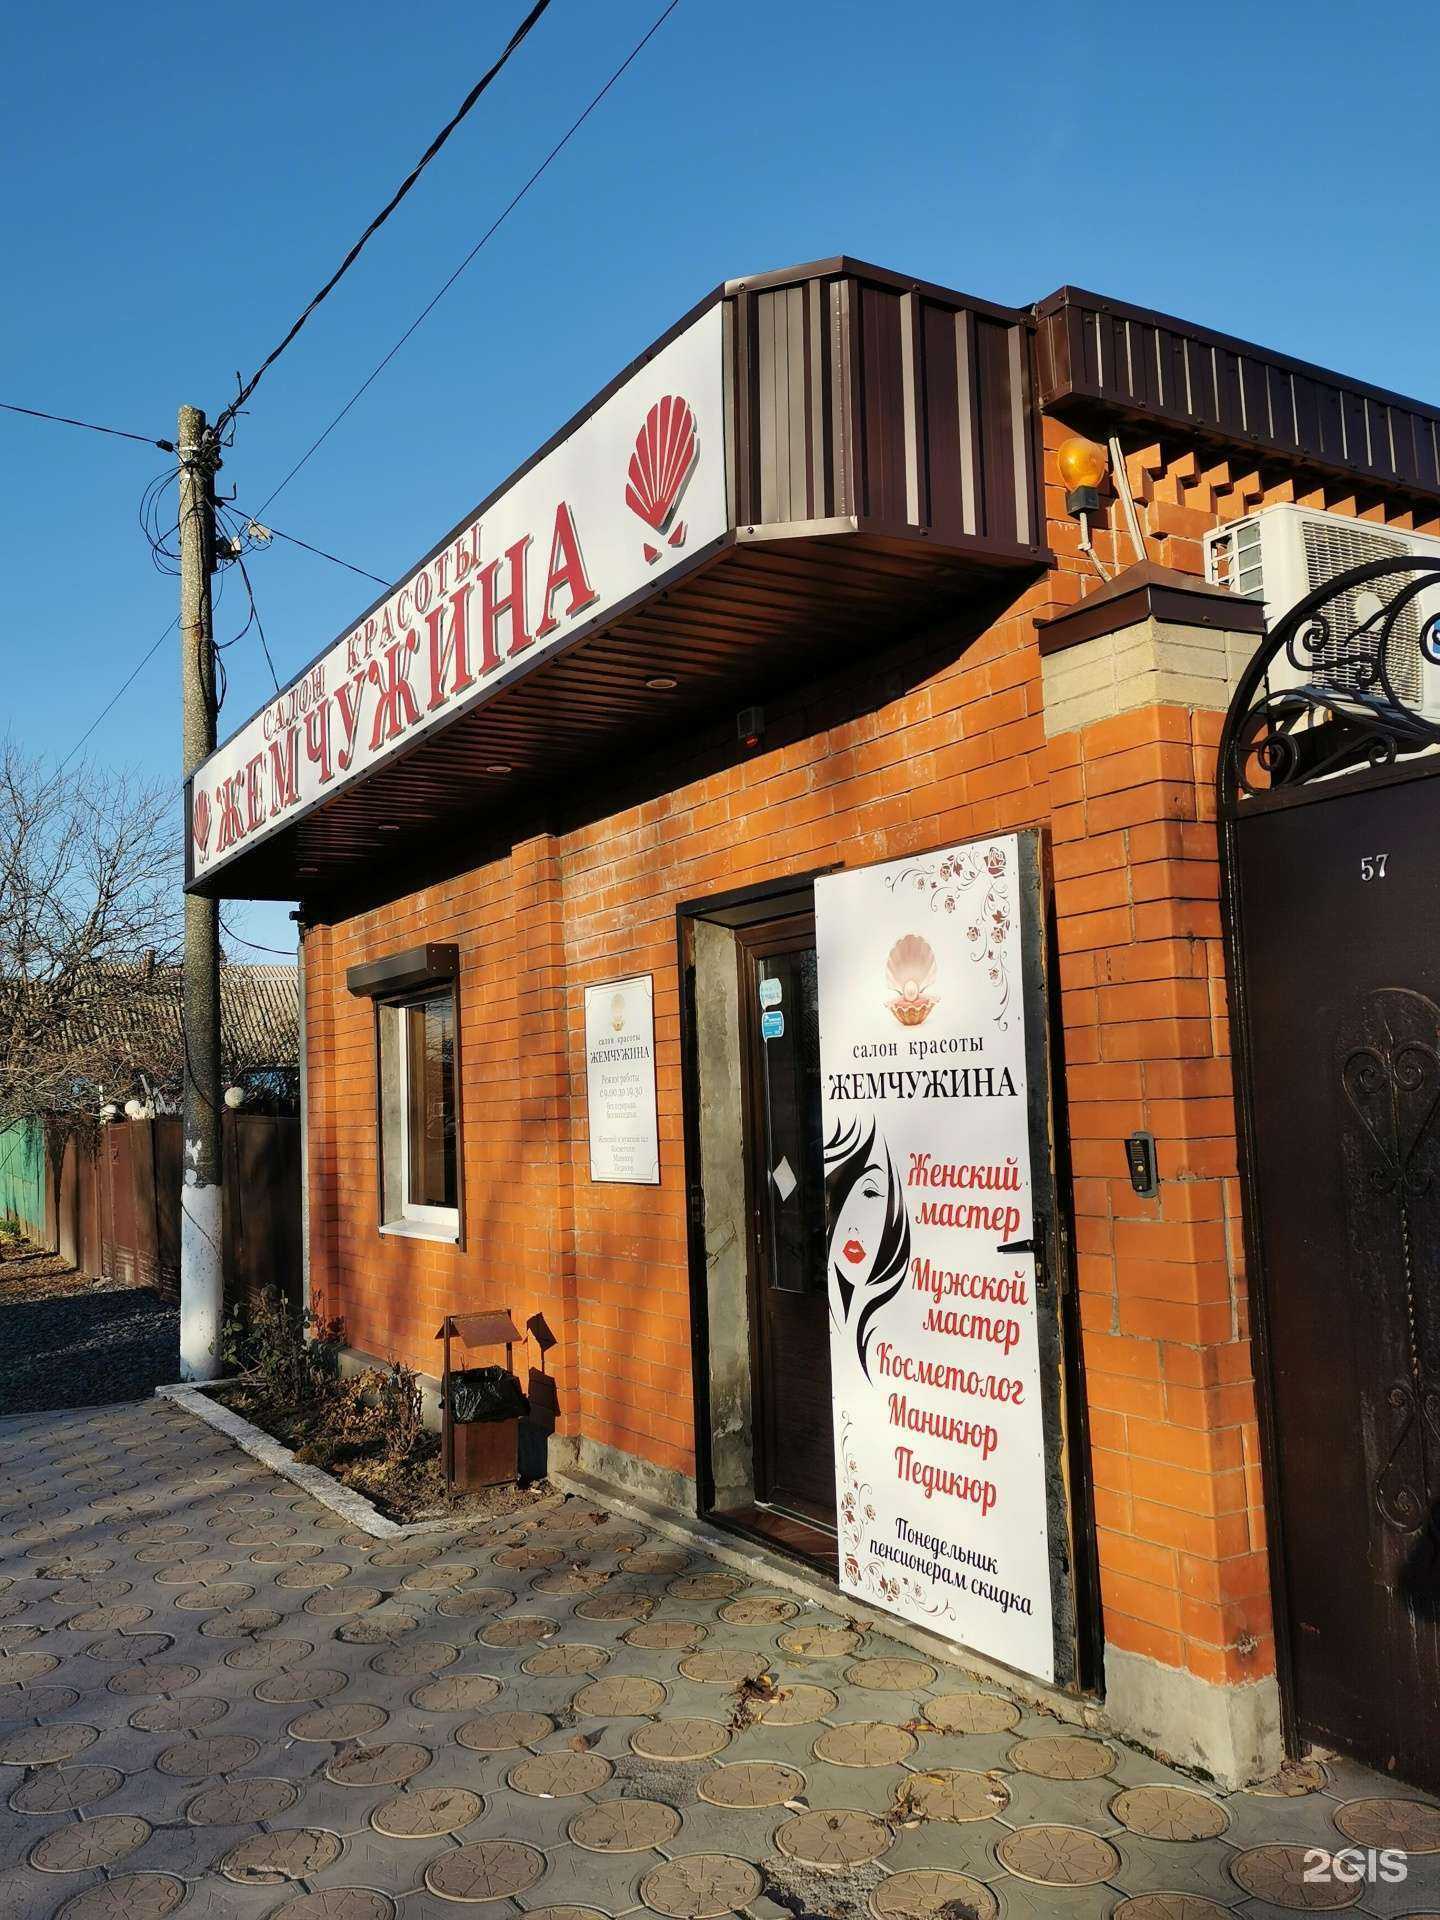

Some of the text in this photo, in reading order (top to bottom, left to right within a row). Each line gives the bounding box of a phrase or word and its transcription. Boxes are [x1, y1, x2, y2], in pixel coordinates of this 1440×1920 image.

[263, 521, 482, 741] САЛОН КРАСОТЫ
[216, 501, 599, 852] ЖЕМЧУЖИНА
[1361, 853, 1389, 881] 57
[590, 1046, 650, 1064] ЖЕМЧУЖИНА
[852, 1036, 983, 1060] салон красоты
[828, 1066, 1018, 1100] ЖЕМЧУЖИНА
[907, 1153, 1022, 1191] Женский
[915, 1202, 1020, 1242] мастер
[911, 1258, 1029, 1305] Мужской
[923, 1308, 1020, 1355] мастер
[876, 1342, 1025, 1405] Косметолог
[888, 1392, 998, 1460] Маникюр
[894, 1446, 997, 1517] Педикюр
[895, 1518, 998, 1575] Понедельник
[869, 1539, 1033, 1616] пенсионерам скидка
